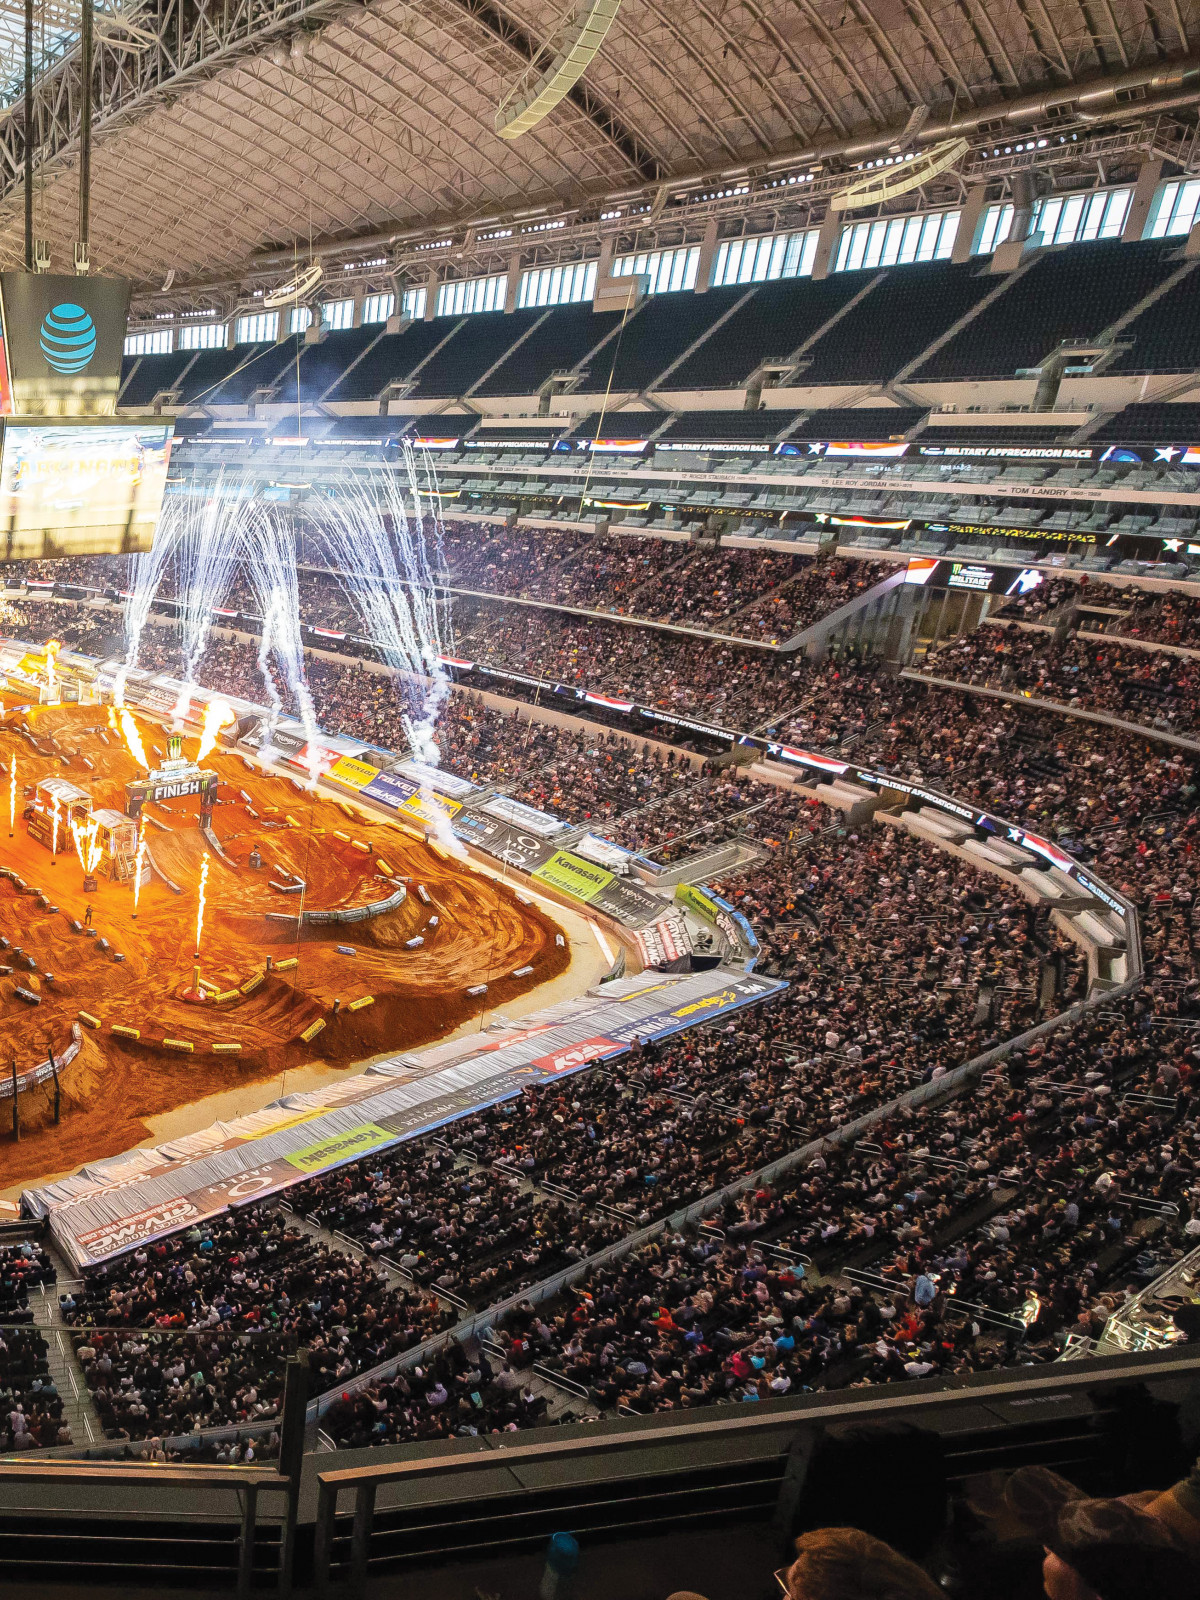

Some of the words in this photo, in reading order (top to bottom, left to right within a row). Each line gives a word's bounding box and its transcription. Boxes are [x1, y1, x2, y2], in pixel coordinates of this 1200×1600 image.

[750, 444, 770, 452] RACE
[943, 447, 988, 456] MILITARY
[989, 448, 1062, 458] APPRECIATION
[1062, 449, 1093, 458] RACE
[1031, 488, 1069, 496] LANDRY
[950, 574, 992, 585] MILITARY
[654, 713, 680, 724] MILITARY
[679, 718, 719, 735] APPRECIATION
[719, 730, 735, 741] RACE
[273, 732, 303, 748] TRIUMPH
[345, 761, 376, 778] DUNLOP
[154, 780, 200, 800] FINISH
[377, 774, 417, 794] FALKEN
[364, 785, 405, 805] FALKEN
[876, 777, 912, 793] MILITARY
[911, 788, 957, 812] APPRECIATION
[956, 806, 974, 819] RACE
[465, 810, 499, 830] GoPro
[451, 823, 485, 844] GoPro
[506, 838, 540, 858] OAKLEY
[554, 855, 606, 886] Kawasaki
[539, 869, 590, 898] Kawasaki
[620, 886, 656, 909] MONSTER
[610, 1017, 659, 1043] YAMAHA
[553, 1038, 622, 1072] FLY
[465, 1074, 516, 1097] COMMISSION
[508, 1077, 524, 1086] UTAH
[472, 1087, 503, 1101] SPORTS
[401, 1103, 457, 1127] MONSTER
[299, 1129, 382, 1166] Kawasaki
[208, 1165, 273, 1195] OAKLEY
[153, 1216, 185, 1233] ROCKY
[94, 1227, 153, 1256] MOUNTAIN
